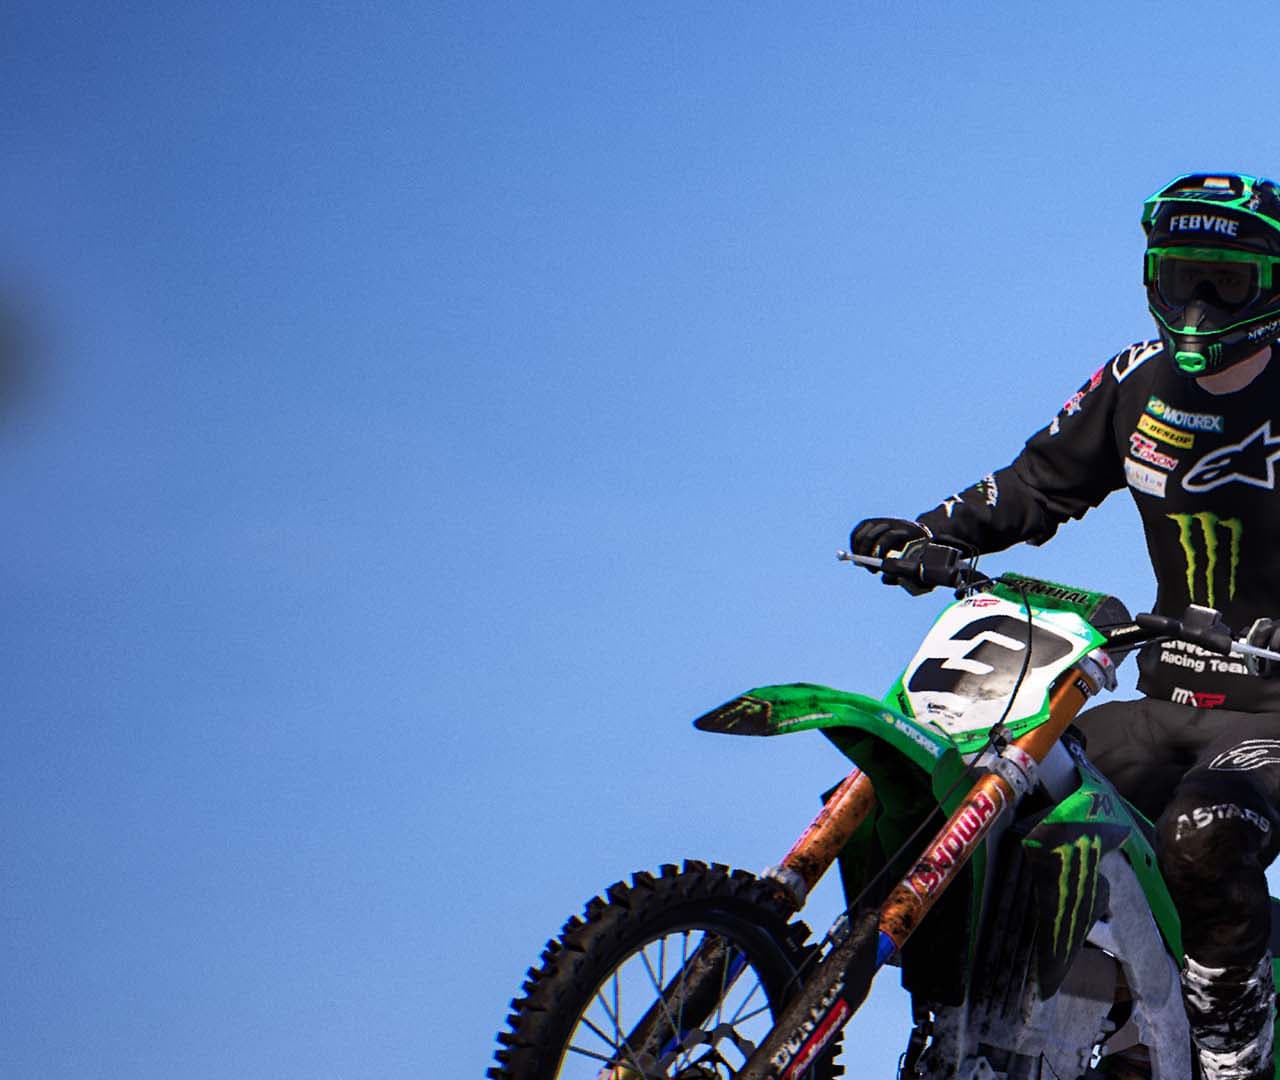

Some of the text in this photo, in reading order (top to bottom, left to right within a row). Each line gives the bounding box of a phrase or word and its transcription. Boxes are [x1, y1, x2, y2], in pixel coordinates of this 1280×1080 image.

[1169, 214, 1240, 236] FEBVRE
[1162, 405, 1221, 432] MOTOREX
[1149, 424, 1192, 445] DUNLOP
[1013, 578, 1090, 604] ENTHAL
[908, 614, 1074, 699] 3
[1160, 650, 1206, 673] Racing
[894, 718, 942, 758] MOTOREX
[914, 790, 997, 898] SHOWA
